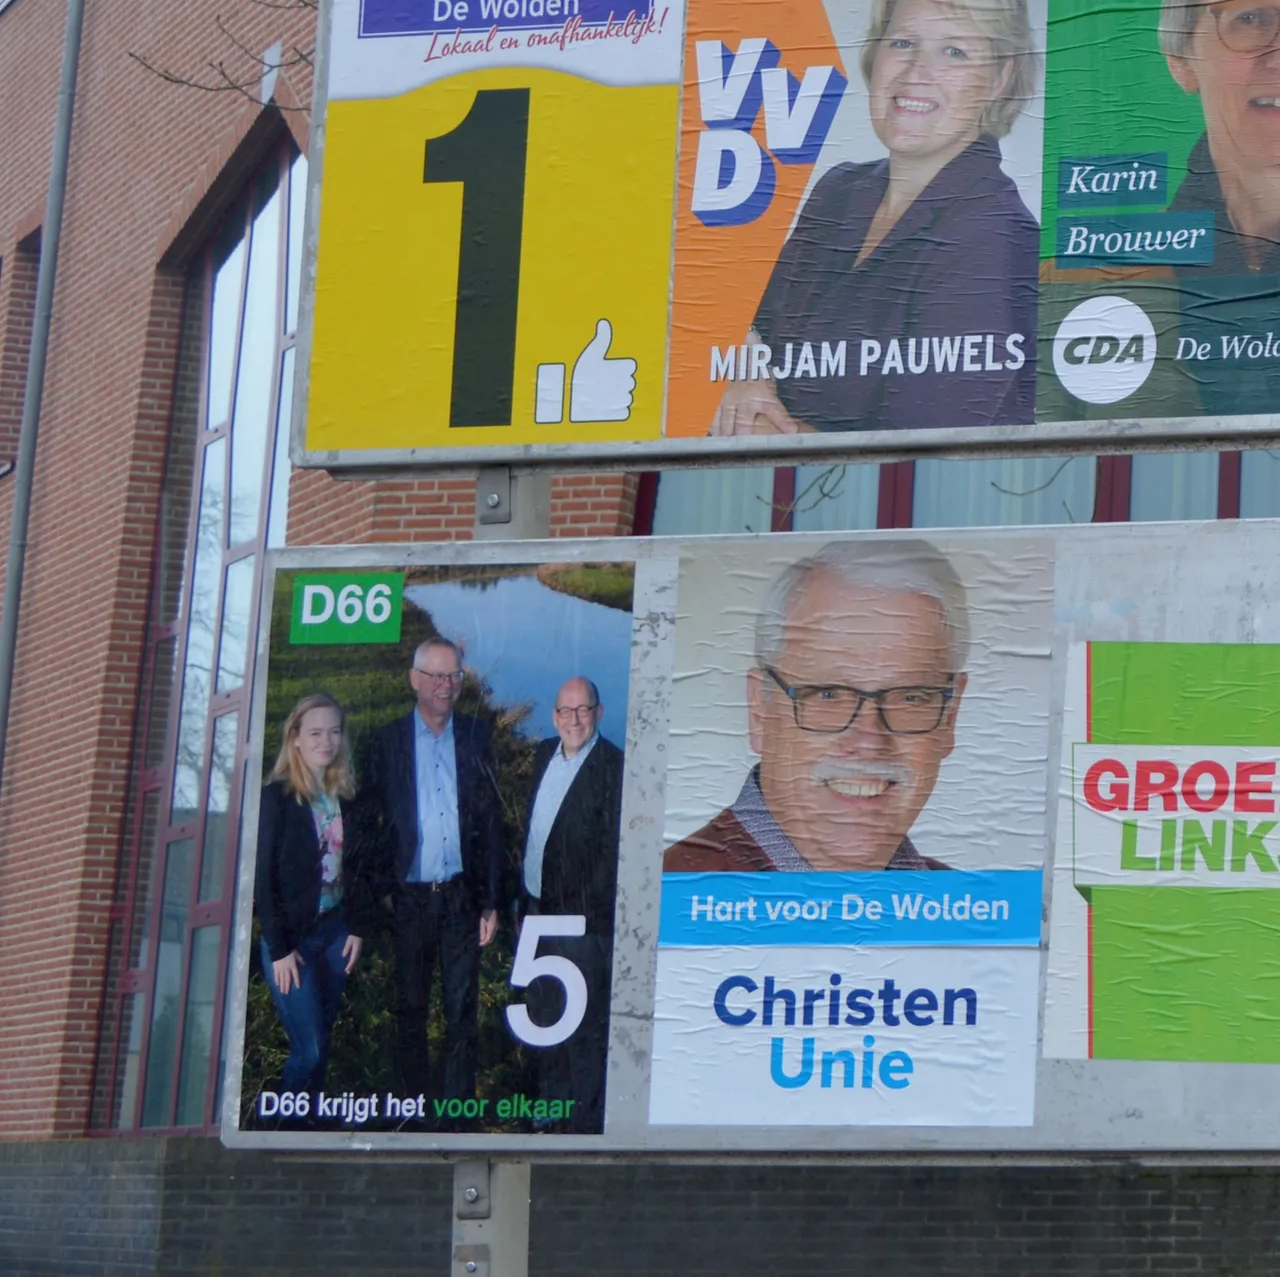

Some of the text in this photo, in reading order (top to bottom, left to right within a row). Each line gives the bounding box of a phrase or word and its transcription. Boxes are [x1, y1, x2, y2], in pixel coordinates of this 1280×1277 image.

[424, 25, 498, 62] Lokaal
[500, 38, 519, 50] en
[1065, 163, 1158, 194] Karin
[423, 88, 530, 427] 1
[1064, 226, 1206, 255] Brouwer
[710, 334, 1026, 381] MIRJAM PAUWELS
[1061, 334, 1146, 364] CDA
[1176, 337, 1214, 361] De
[301, 583, 393, 625] D66
[690, 894, 1010, 924] Hart voor De Wolden
[506, 915, 588, 1047] 5
[713, 974, 977, 1027] Christen
[769, 1036, 915, 1090] Unie
[259, 1092, 574, 1122] D66 krijgt het voor elkaar
